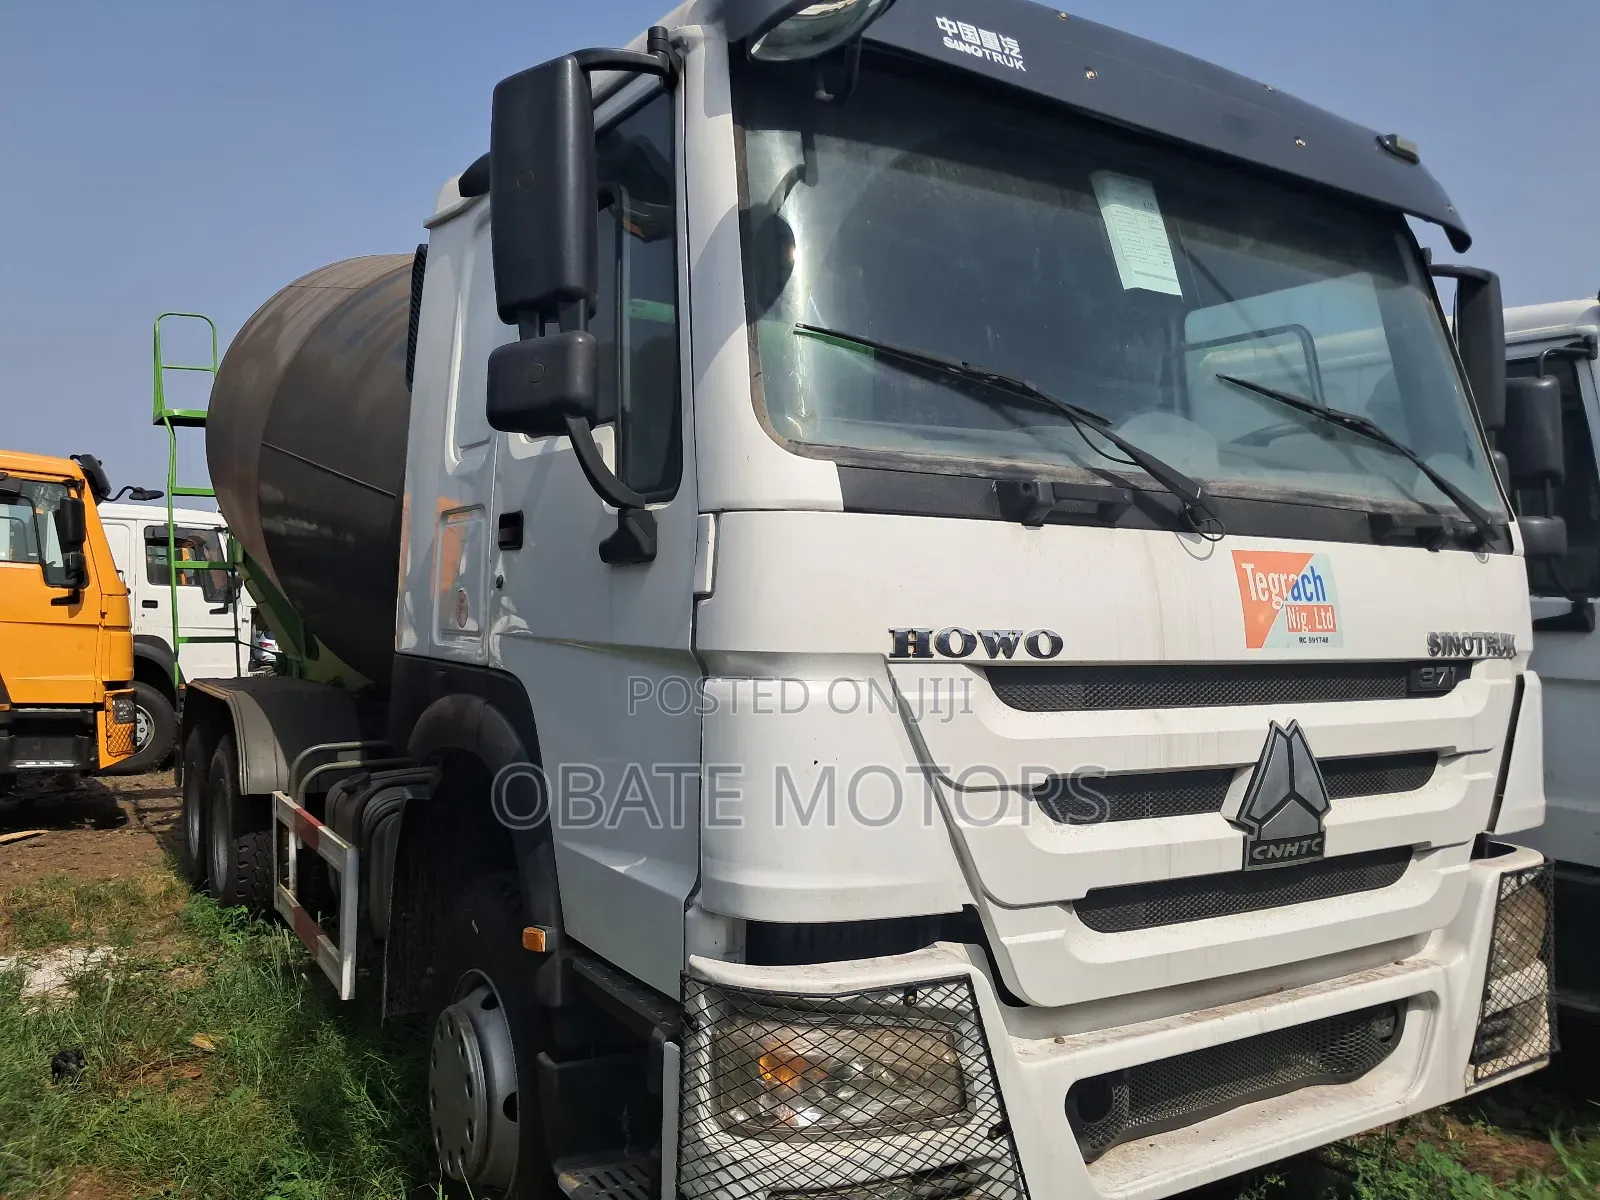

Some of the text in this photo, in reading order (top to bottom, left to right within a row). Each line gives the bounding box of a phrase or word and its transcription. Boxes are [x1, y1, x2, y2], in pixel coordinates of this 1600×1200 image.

[935, 16, 1023, 59] 中国重汽
[942, 36, 1027, 72] SINOTRUK
[1240, 562, 1327, 610] Tegrach
[1287, 606, 1334, 632] Nig. Ltd
[888, 626, 1064, 660] HOWO
[1298, 636, 1308, 644] RC
[1426, 631, 1517, 658] SINOTRUK
[1420, 666, 1457, 687] 371
[1252, 837, 1322, 861] CNHTC
